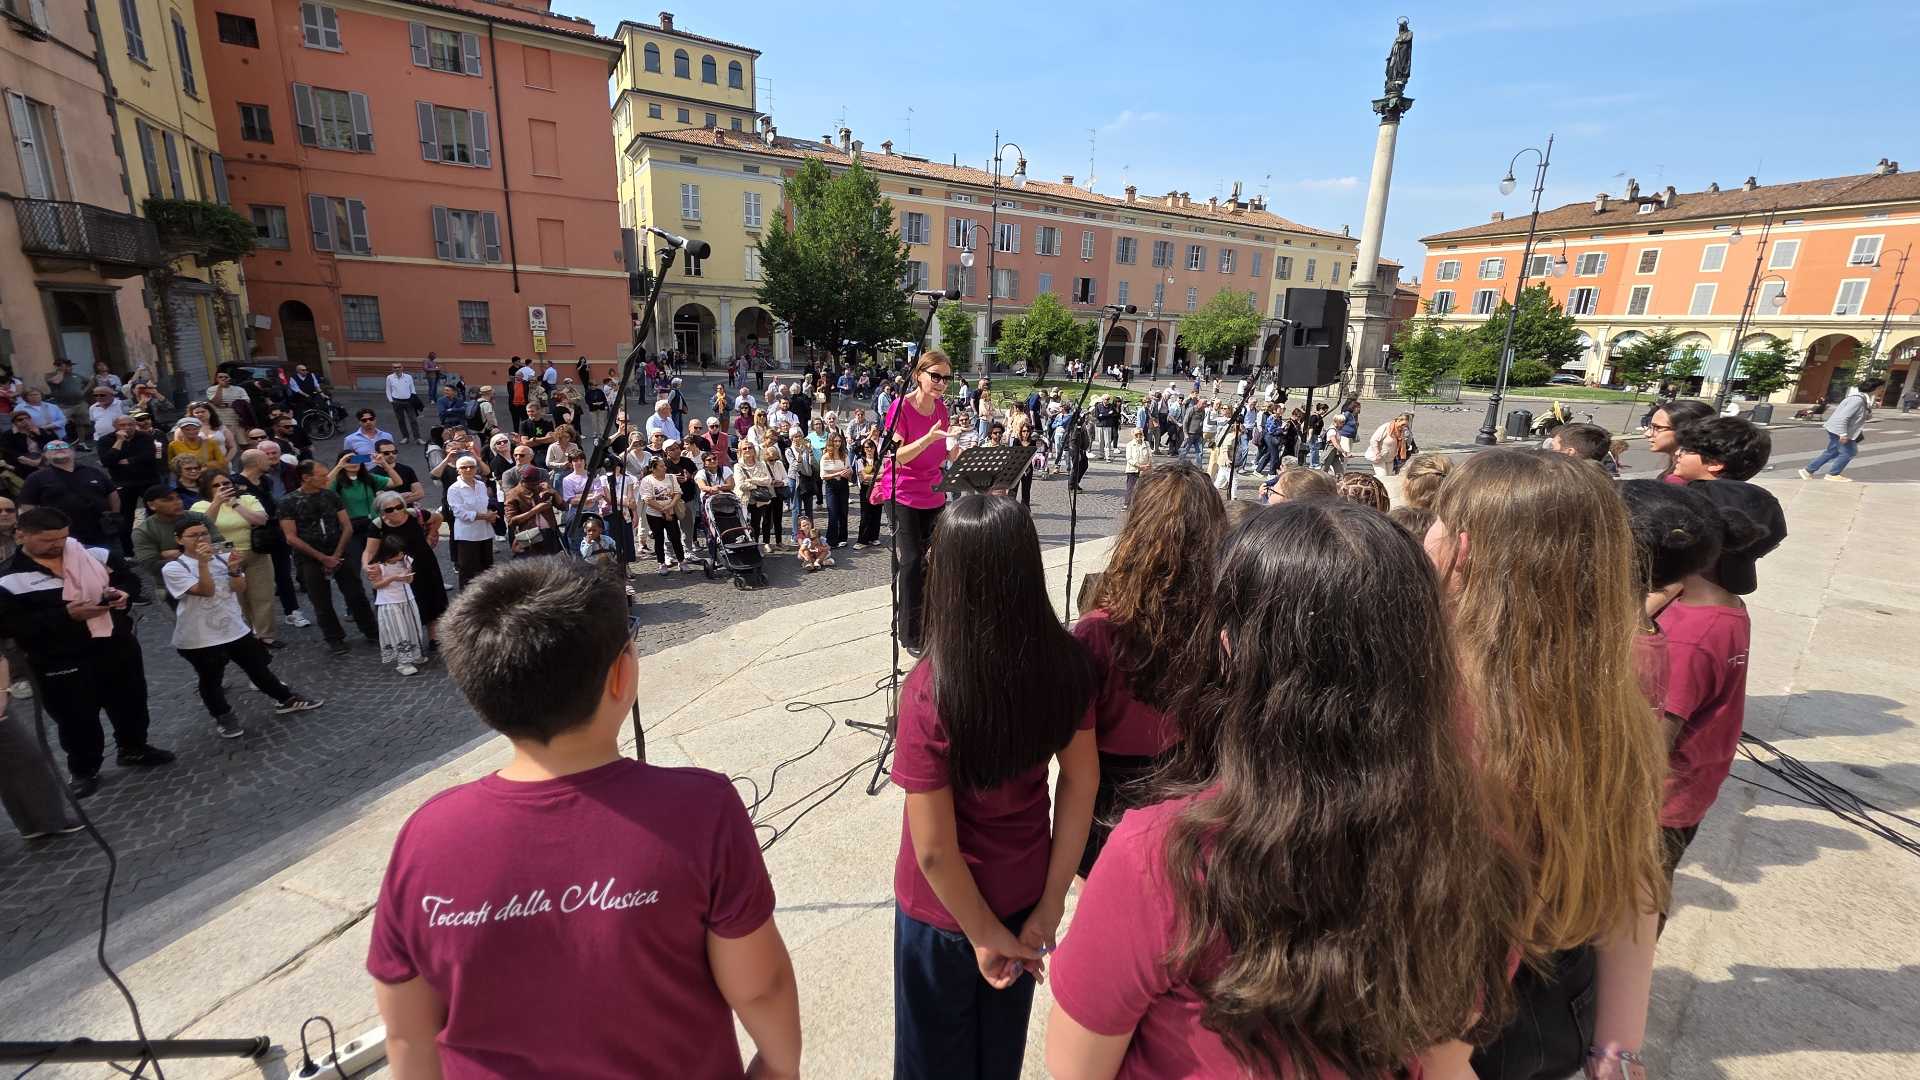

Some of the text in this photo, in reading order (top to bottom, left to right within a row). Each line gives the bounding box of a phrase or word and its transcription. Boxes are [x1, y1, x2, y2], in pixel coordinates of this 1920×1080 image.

[421, 876, 660, 928] Toccati dalla Musica
